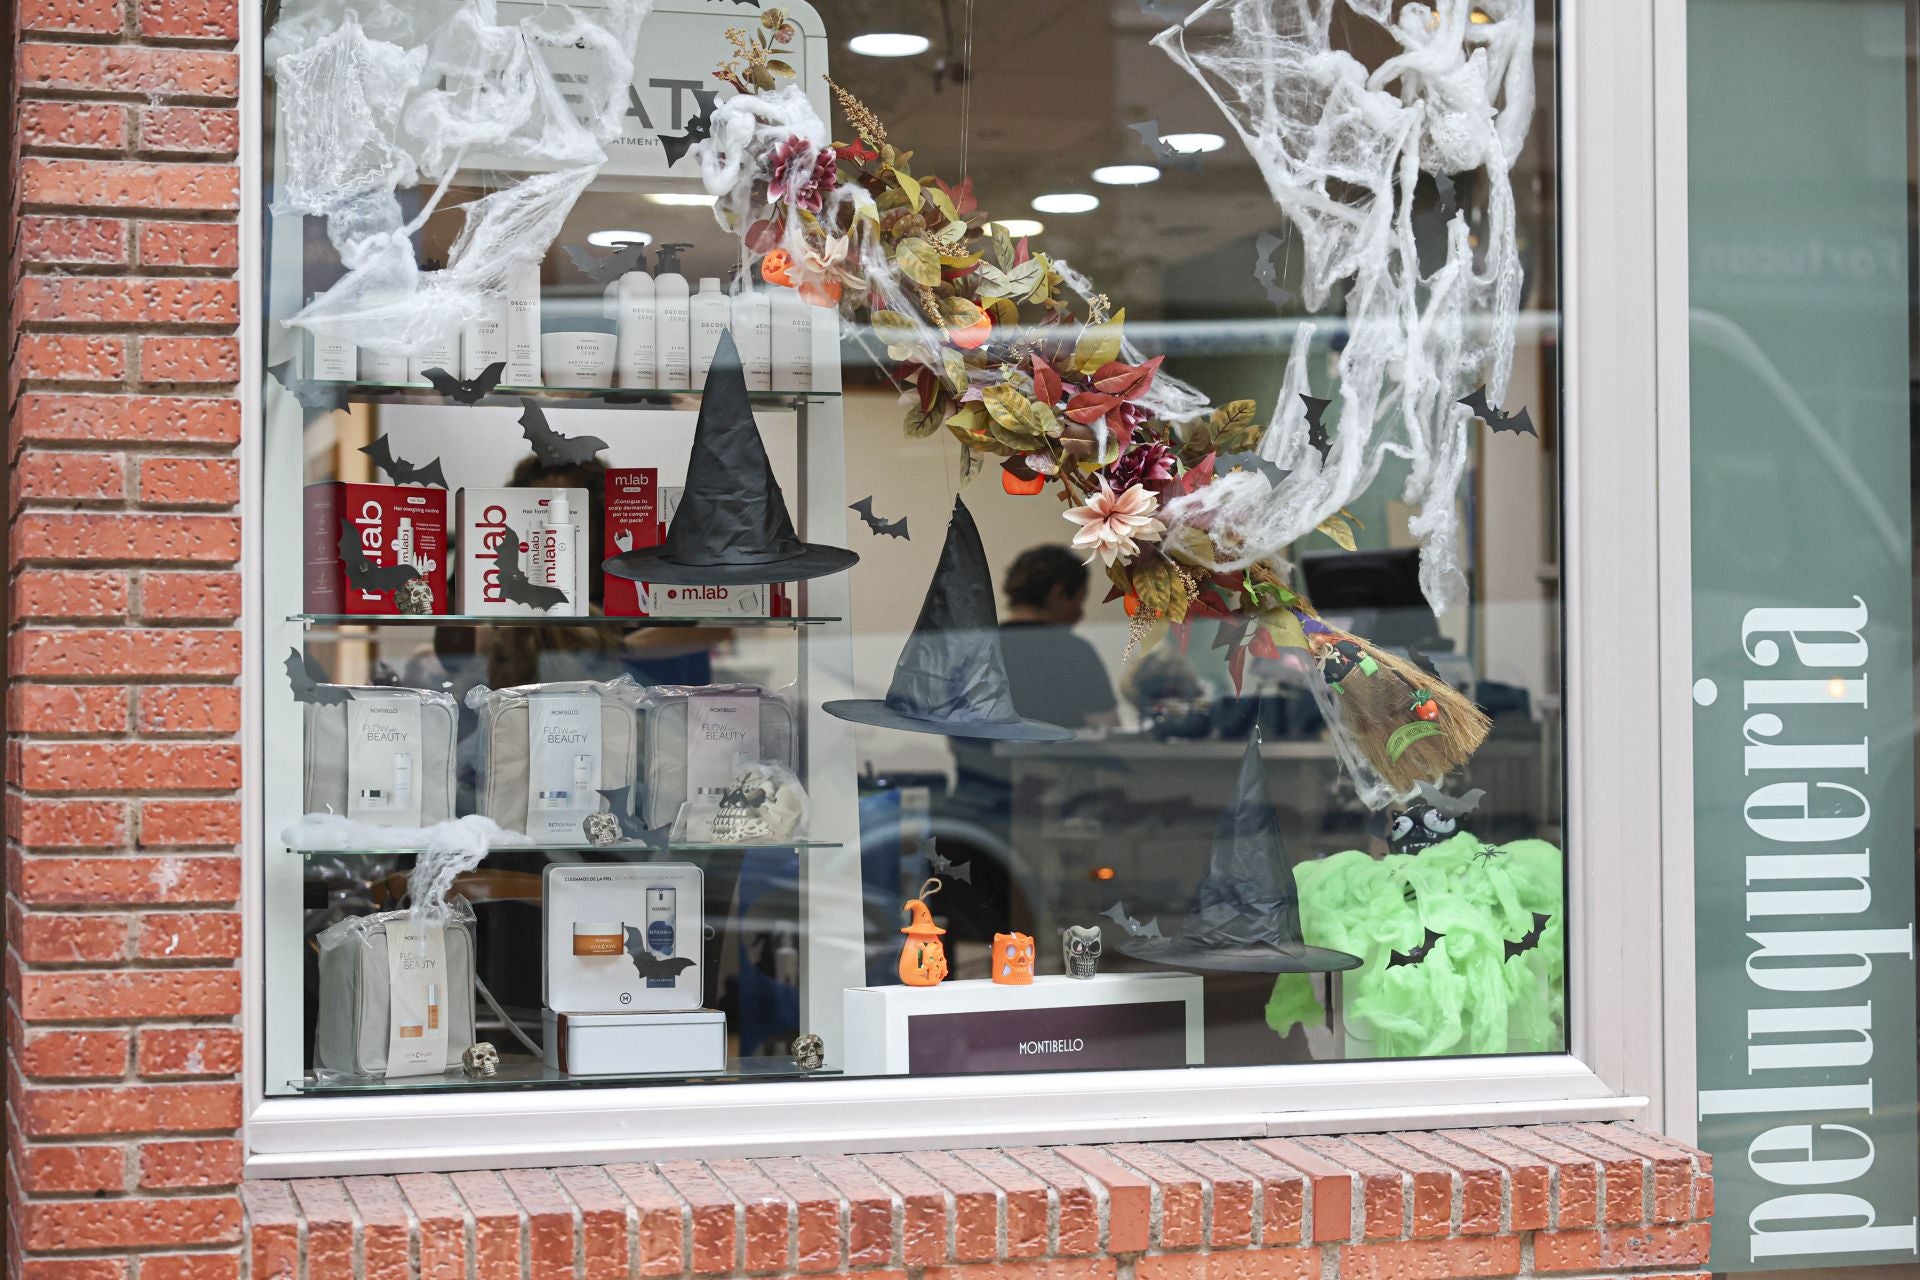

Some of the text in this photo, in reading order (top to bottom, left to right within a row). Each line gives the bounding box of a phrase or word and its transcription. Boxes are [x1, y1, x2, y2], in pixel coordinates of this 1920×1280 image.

[615, 474, 649, 485] m.lab
[401, 534, 409, 563] m.lab
[531, 535, 541, 565] m.lab
[544, 536, 557, 583] m.lab
[682, 585, 728, 599] m.lab
[363, 723, 389, 732] FLOW
[543, 726, 569, 735] FLOW
[702, 723, 727, 731] FLOW
[367, 732, 408, 742] BEAUTY
[547, 734, 588, 744] BEAUTY
[706, 731, 746, 741] BEAUTY
[1019, 1038, 1084, 1055] MONTIBELLO
